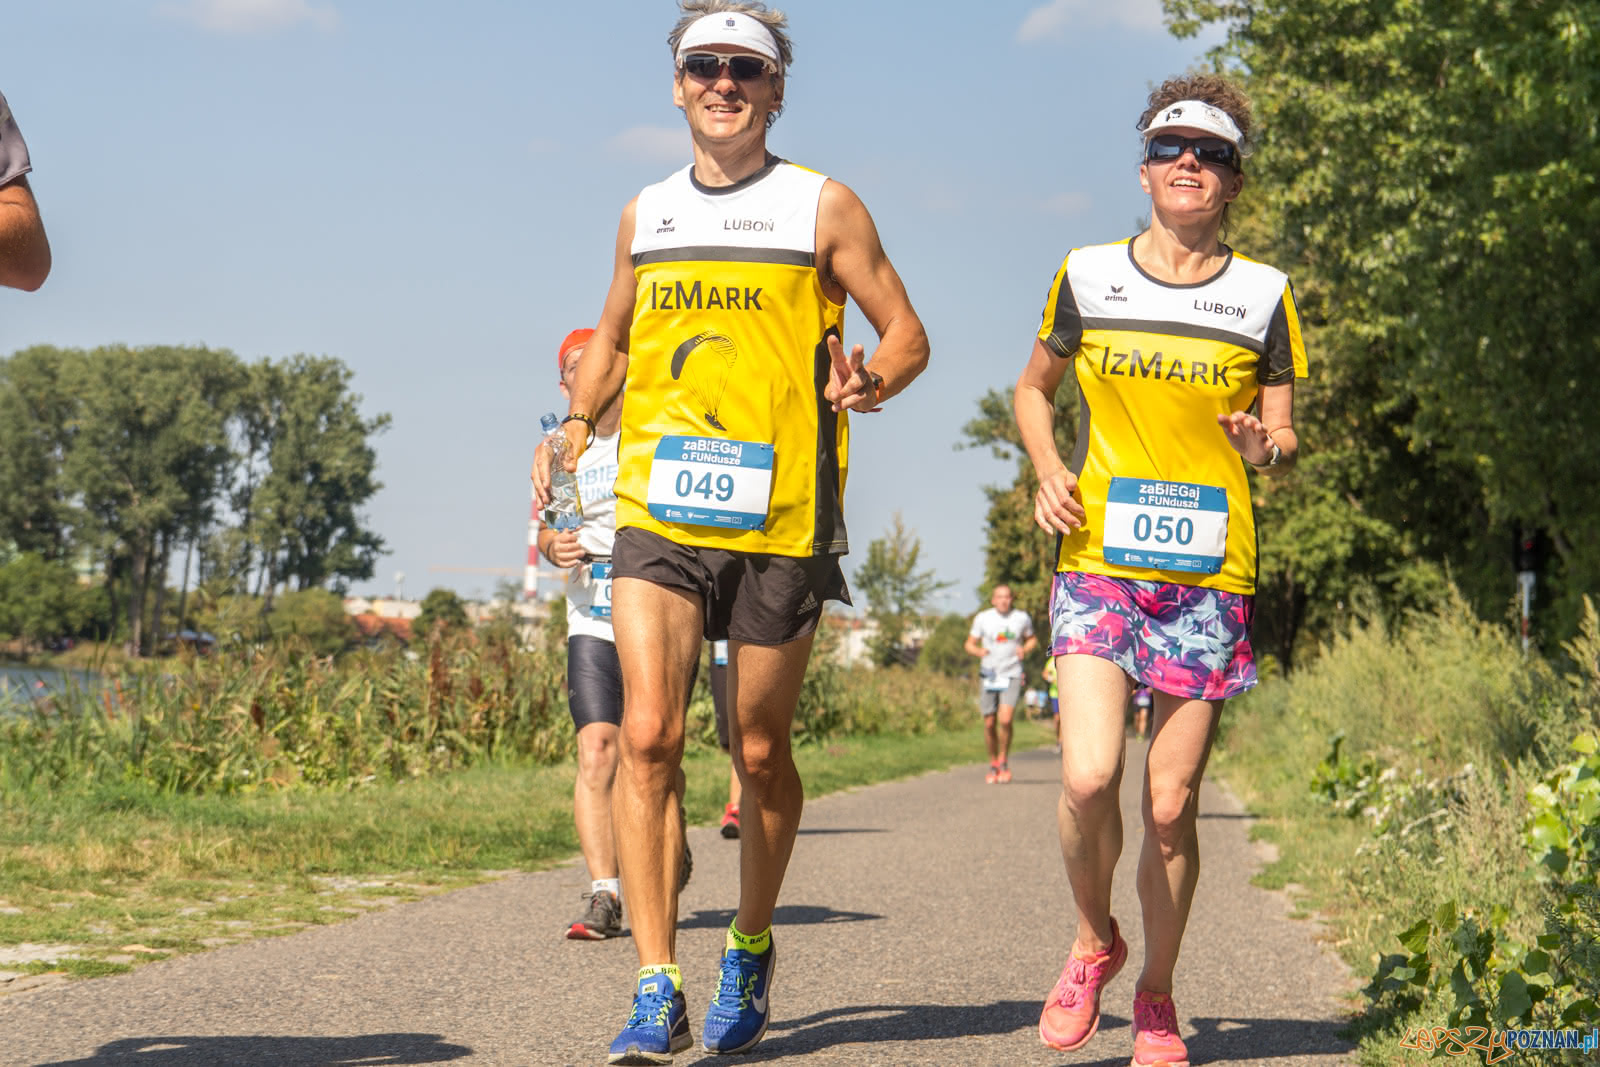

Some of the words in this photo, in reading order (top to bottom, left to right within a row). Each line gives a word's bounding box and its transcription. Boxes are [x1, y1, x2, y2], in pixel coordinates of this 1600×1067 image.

[724, 219, 775, 232] LUBOŃ
[1104, 294, 1128, 302] erima
[1193, 299, 1247, 319] LUBOŃ
[681, 453, 688, 461] o
[690, 451, 741, 465] FUNdusze
[675, 469, 735, 502] 049
[1138, 496, 1146, 504] o
[1148, 495, 1199, 509] FUNdusze
[1133, 513, 1194, 546] 050
